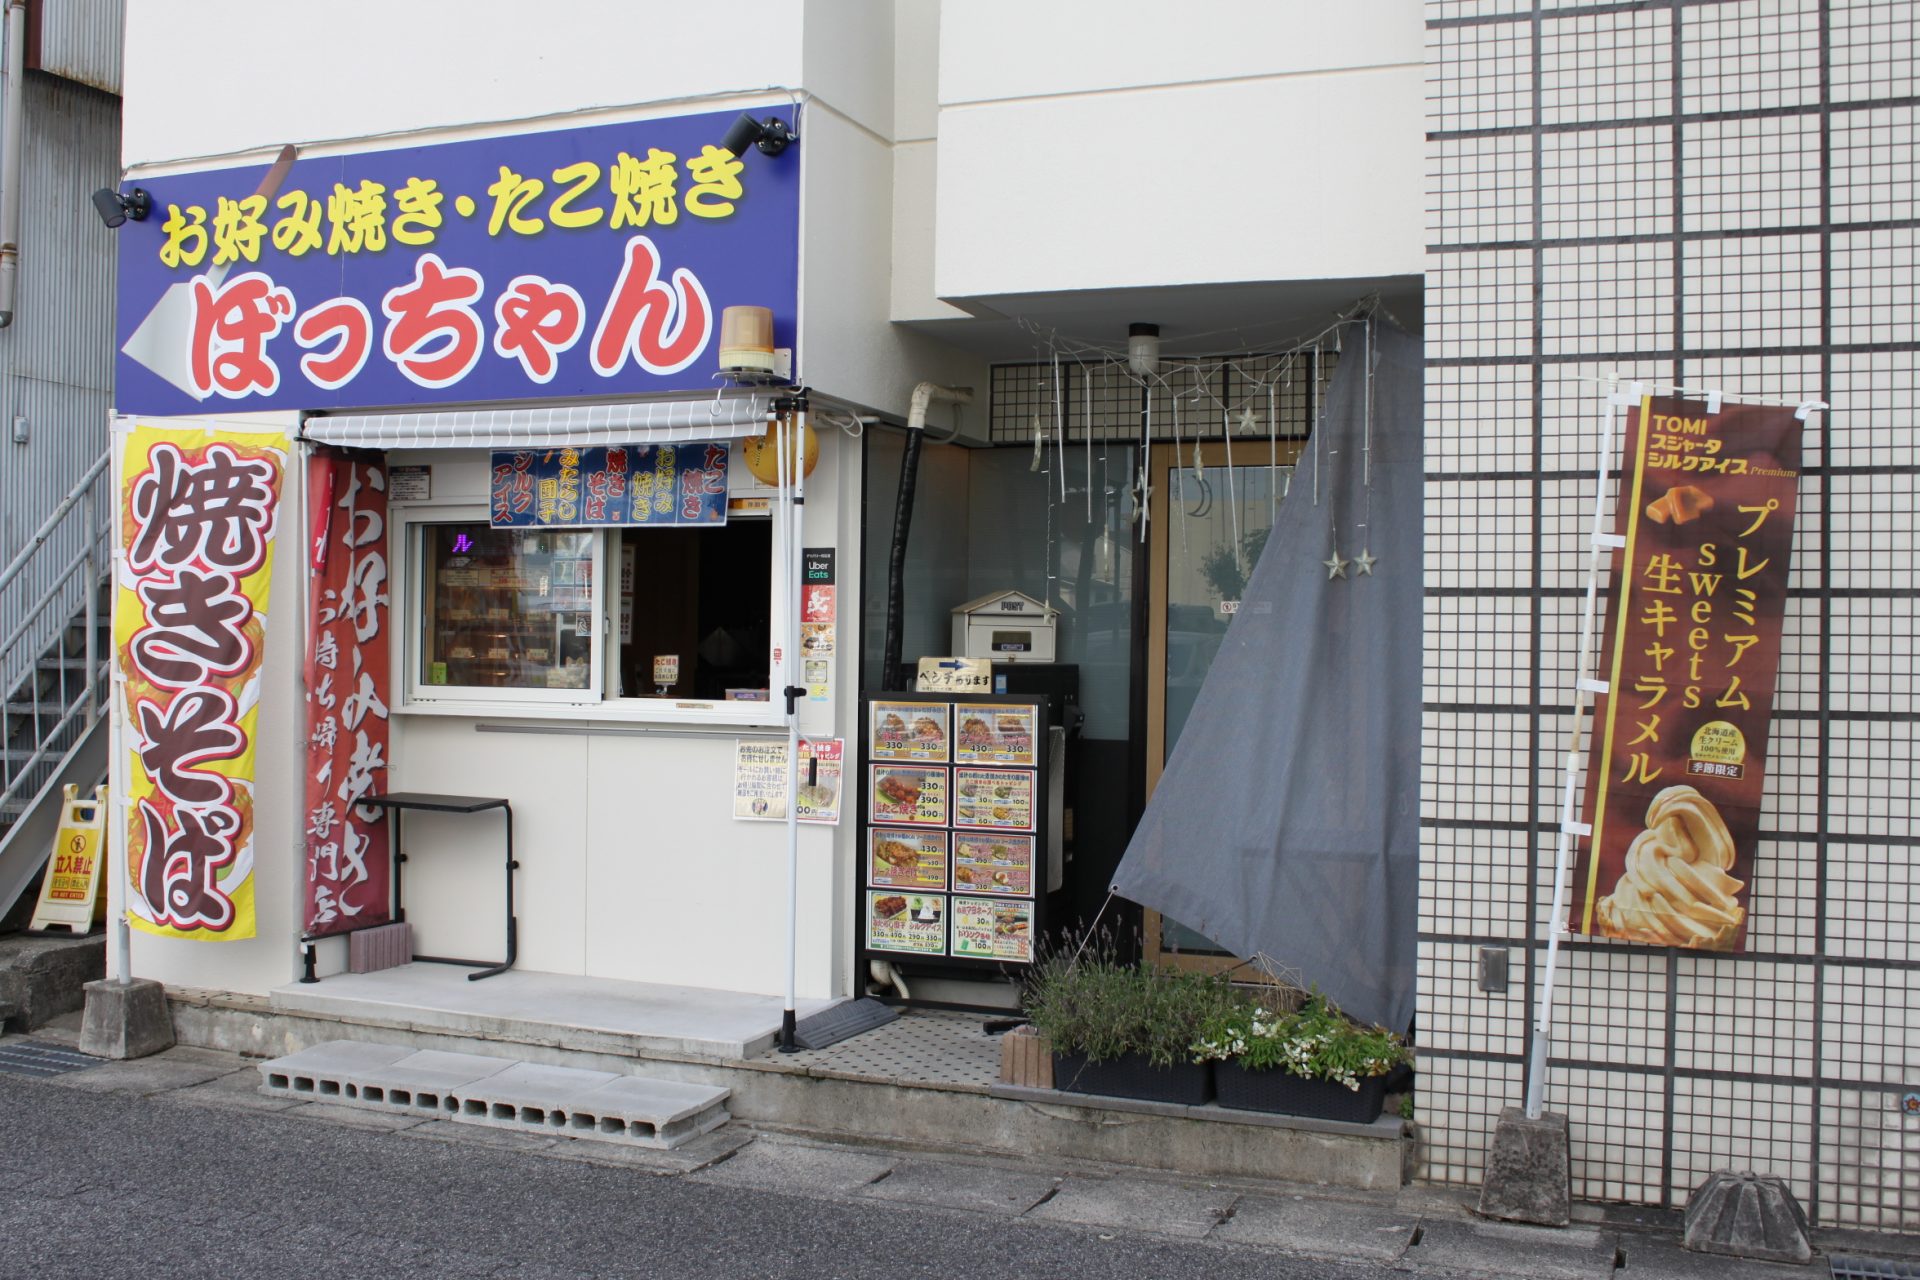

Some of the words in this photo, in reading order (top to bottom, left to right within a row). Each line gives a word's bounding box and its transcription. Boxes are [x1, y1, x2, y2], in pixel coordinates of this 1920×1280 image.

[185, 235, 712, 399] ぼっちゃん
[1650, 434, 1722, 454] スジャータ
[1653, 414, 1708, 435] TOMI
[512, 450, 534, 513] シルク
[558, 447, 580, 521] みたらし
[606, 448, 628, 497] 焼き
[654, 446, 677, 514] お好み
[704, 444, 727, 494] たこ
[1648, 452, 1748, 475] シルクアイス
[1750, 466, 1797, 478] Premium
[492, 464, 513, 523] アイス
[585, 471, 607, 520] そば
[632, 470, 654, 521] 焼き
[682, 467, 704, 519] 焼き
[808, 561, 828, 570] Uber
[808, 570, 829, 579] Eats
[1683, 542, 1723, 710] sweets
[1715, 498, 1779, 713] プレミアム
[129, 441, 278, 931] 焼きそば
[1621, 553, 1684, 785] 生キャラメル
[801, 743, 832, 753] た焼き
[1699, 736, 1738, 746] 生クリーム
[1704, 727, 1737, 737] 北海道産
[1692, 762, 1738, 777] 季節限定
[54, 856, 93, 875] 立入禁止
